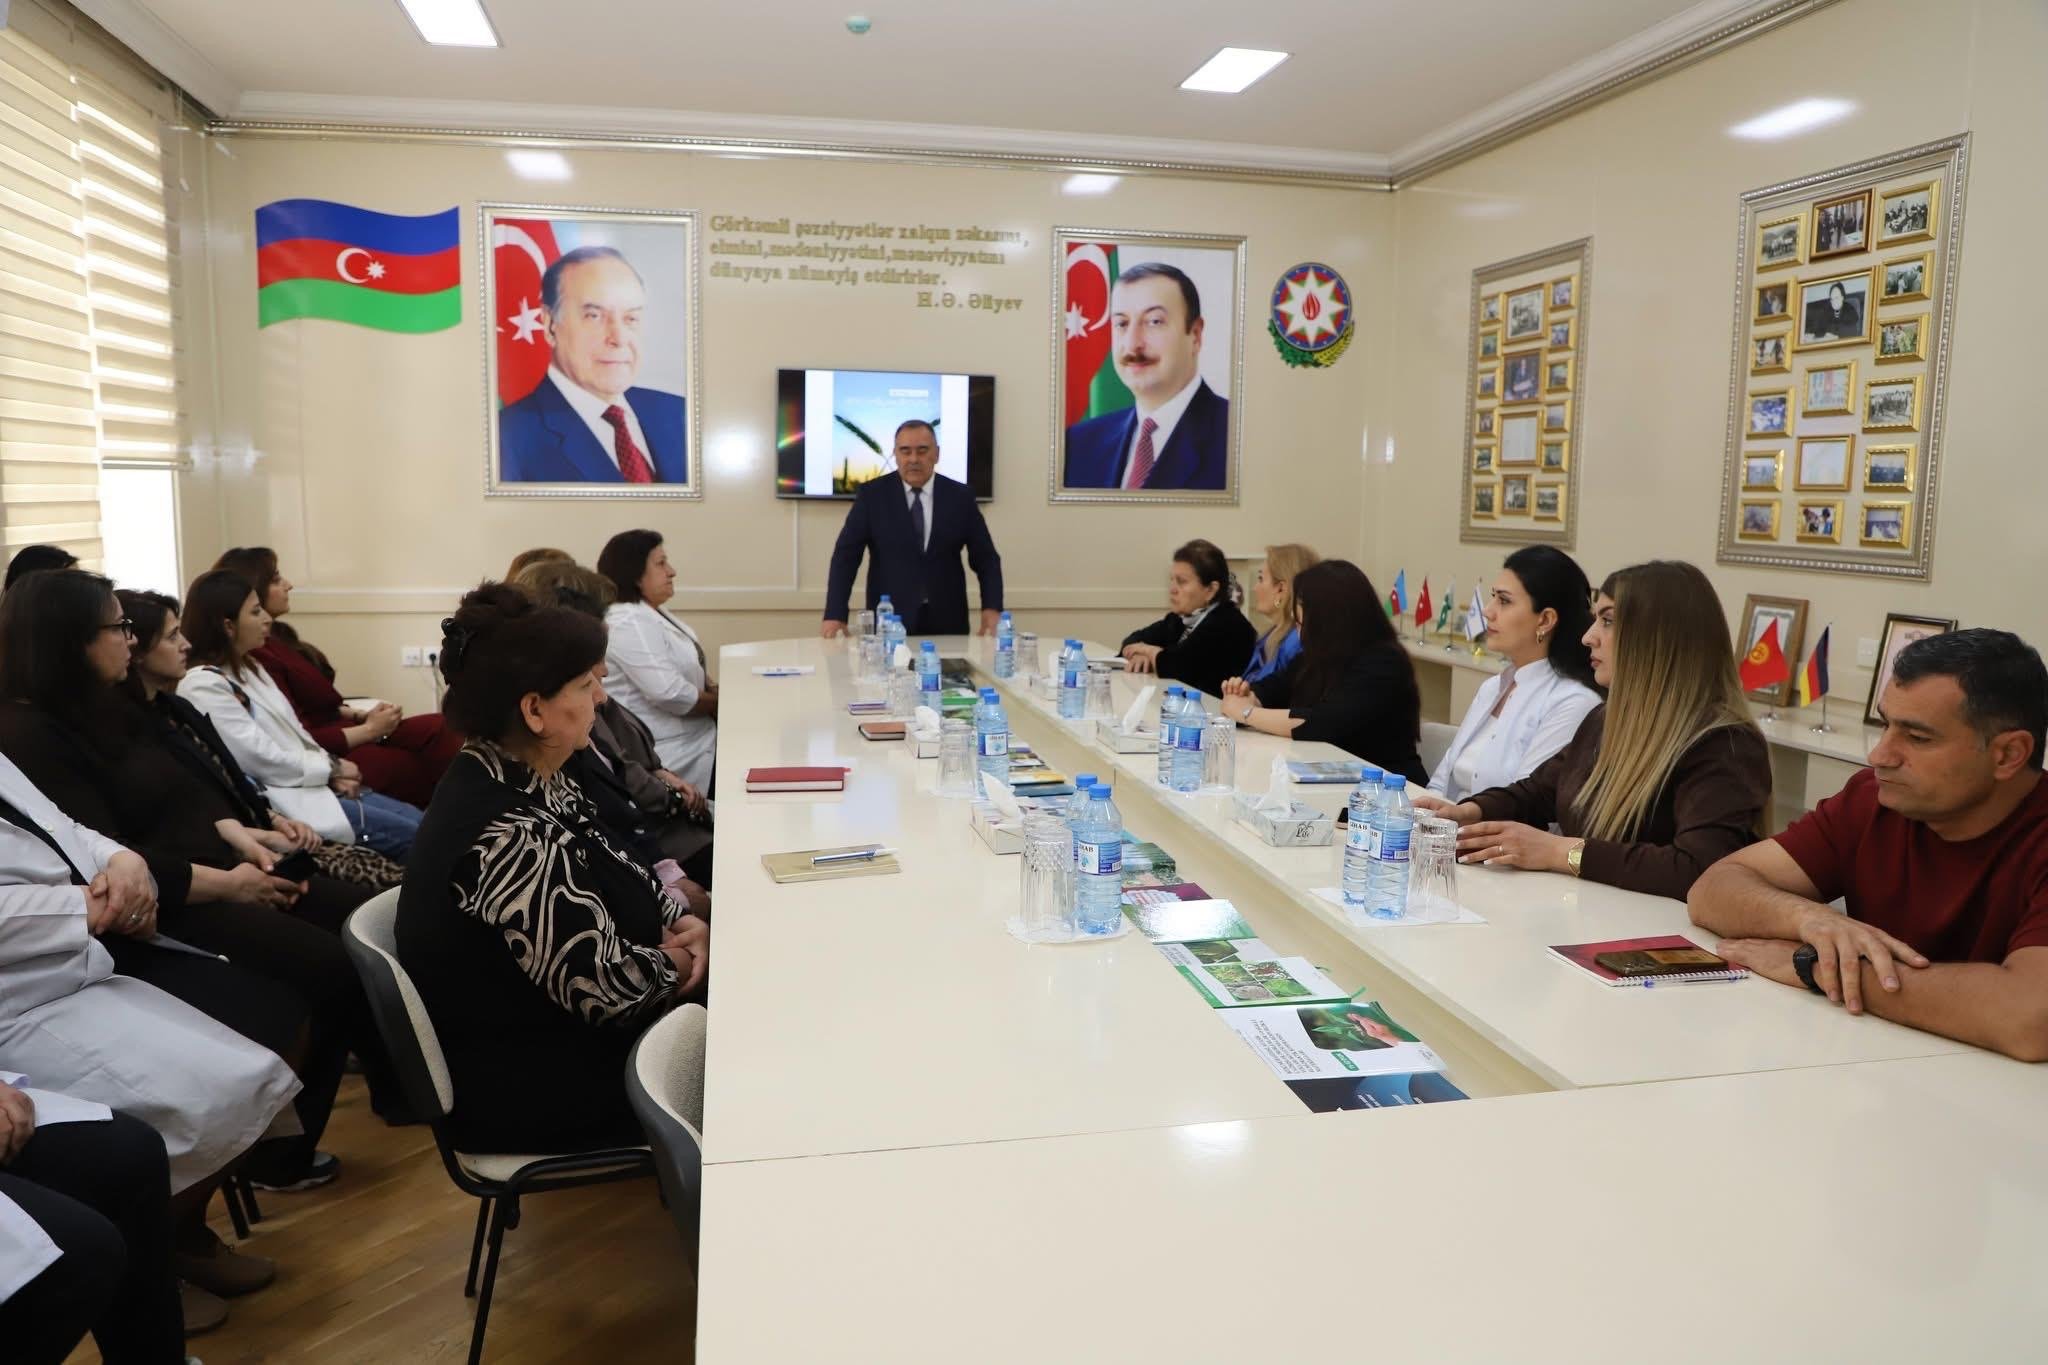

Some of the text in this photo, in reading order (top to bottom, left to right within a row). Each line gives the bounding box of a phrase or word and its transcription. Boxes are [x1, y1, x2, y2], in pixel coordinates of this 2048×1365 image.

[710, 215, 790, 234] Görkəmli
[796, 220, 893, 240] şəxsiyyətlər
[710, 261, 783, 283] dünyaya
[788, 264, 858, 286] nümayiş
[968, 293, 1023, 314] Əliyev
